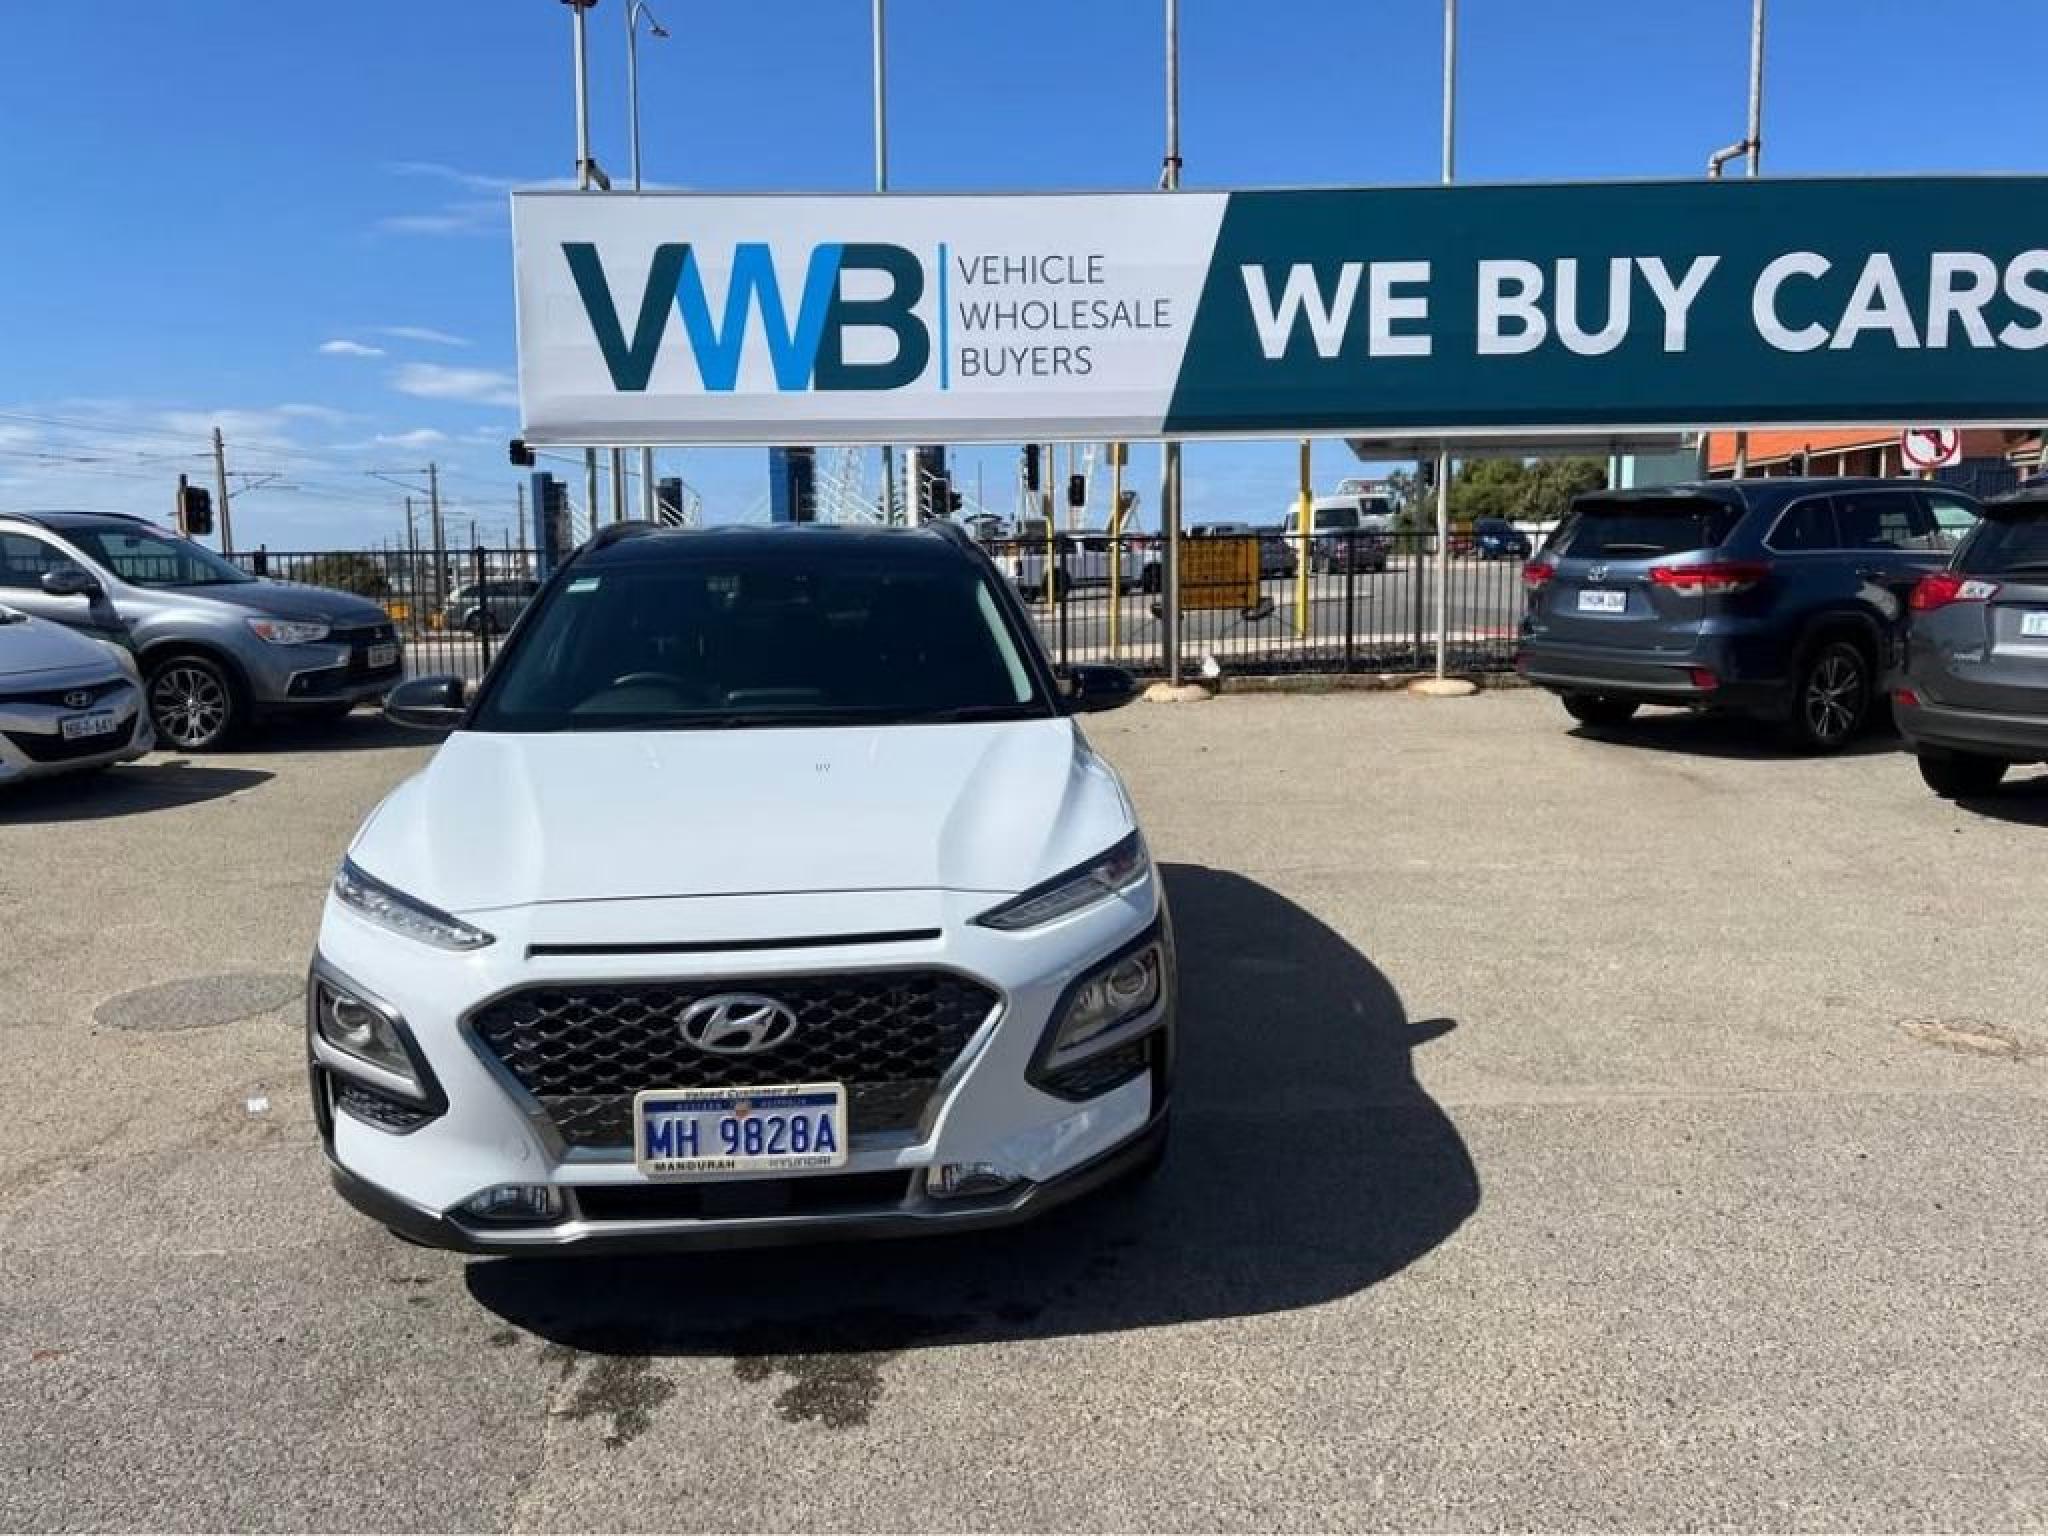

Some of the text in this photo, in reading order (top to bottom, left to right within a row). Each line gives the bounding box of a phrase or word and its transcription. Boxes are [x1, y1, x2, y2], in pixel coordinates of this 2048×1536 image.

[958, 255, 1105, 285] VEHICLE
[560, 241, 930, 392] VWB
[959, 299, 1172, 330] WHOLESALE
[1242, 250, 2048, 358] WE BUY CARS
[961, 345, 1093, 377] BUYERS
[645, 1113, 837, 1159] MH 9828A
[653, 1159, 735, 1172] MANDURAH
